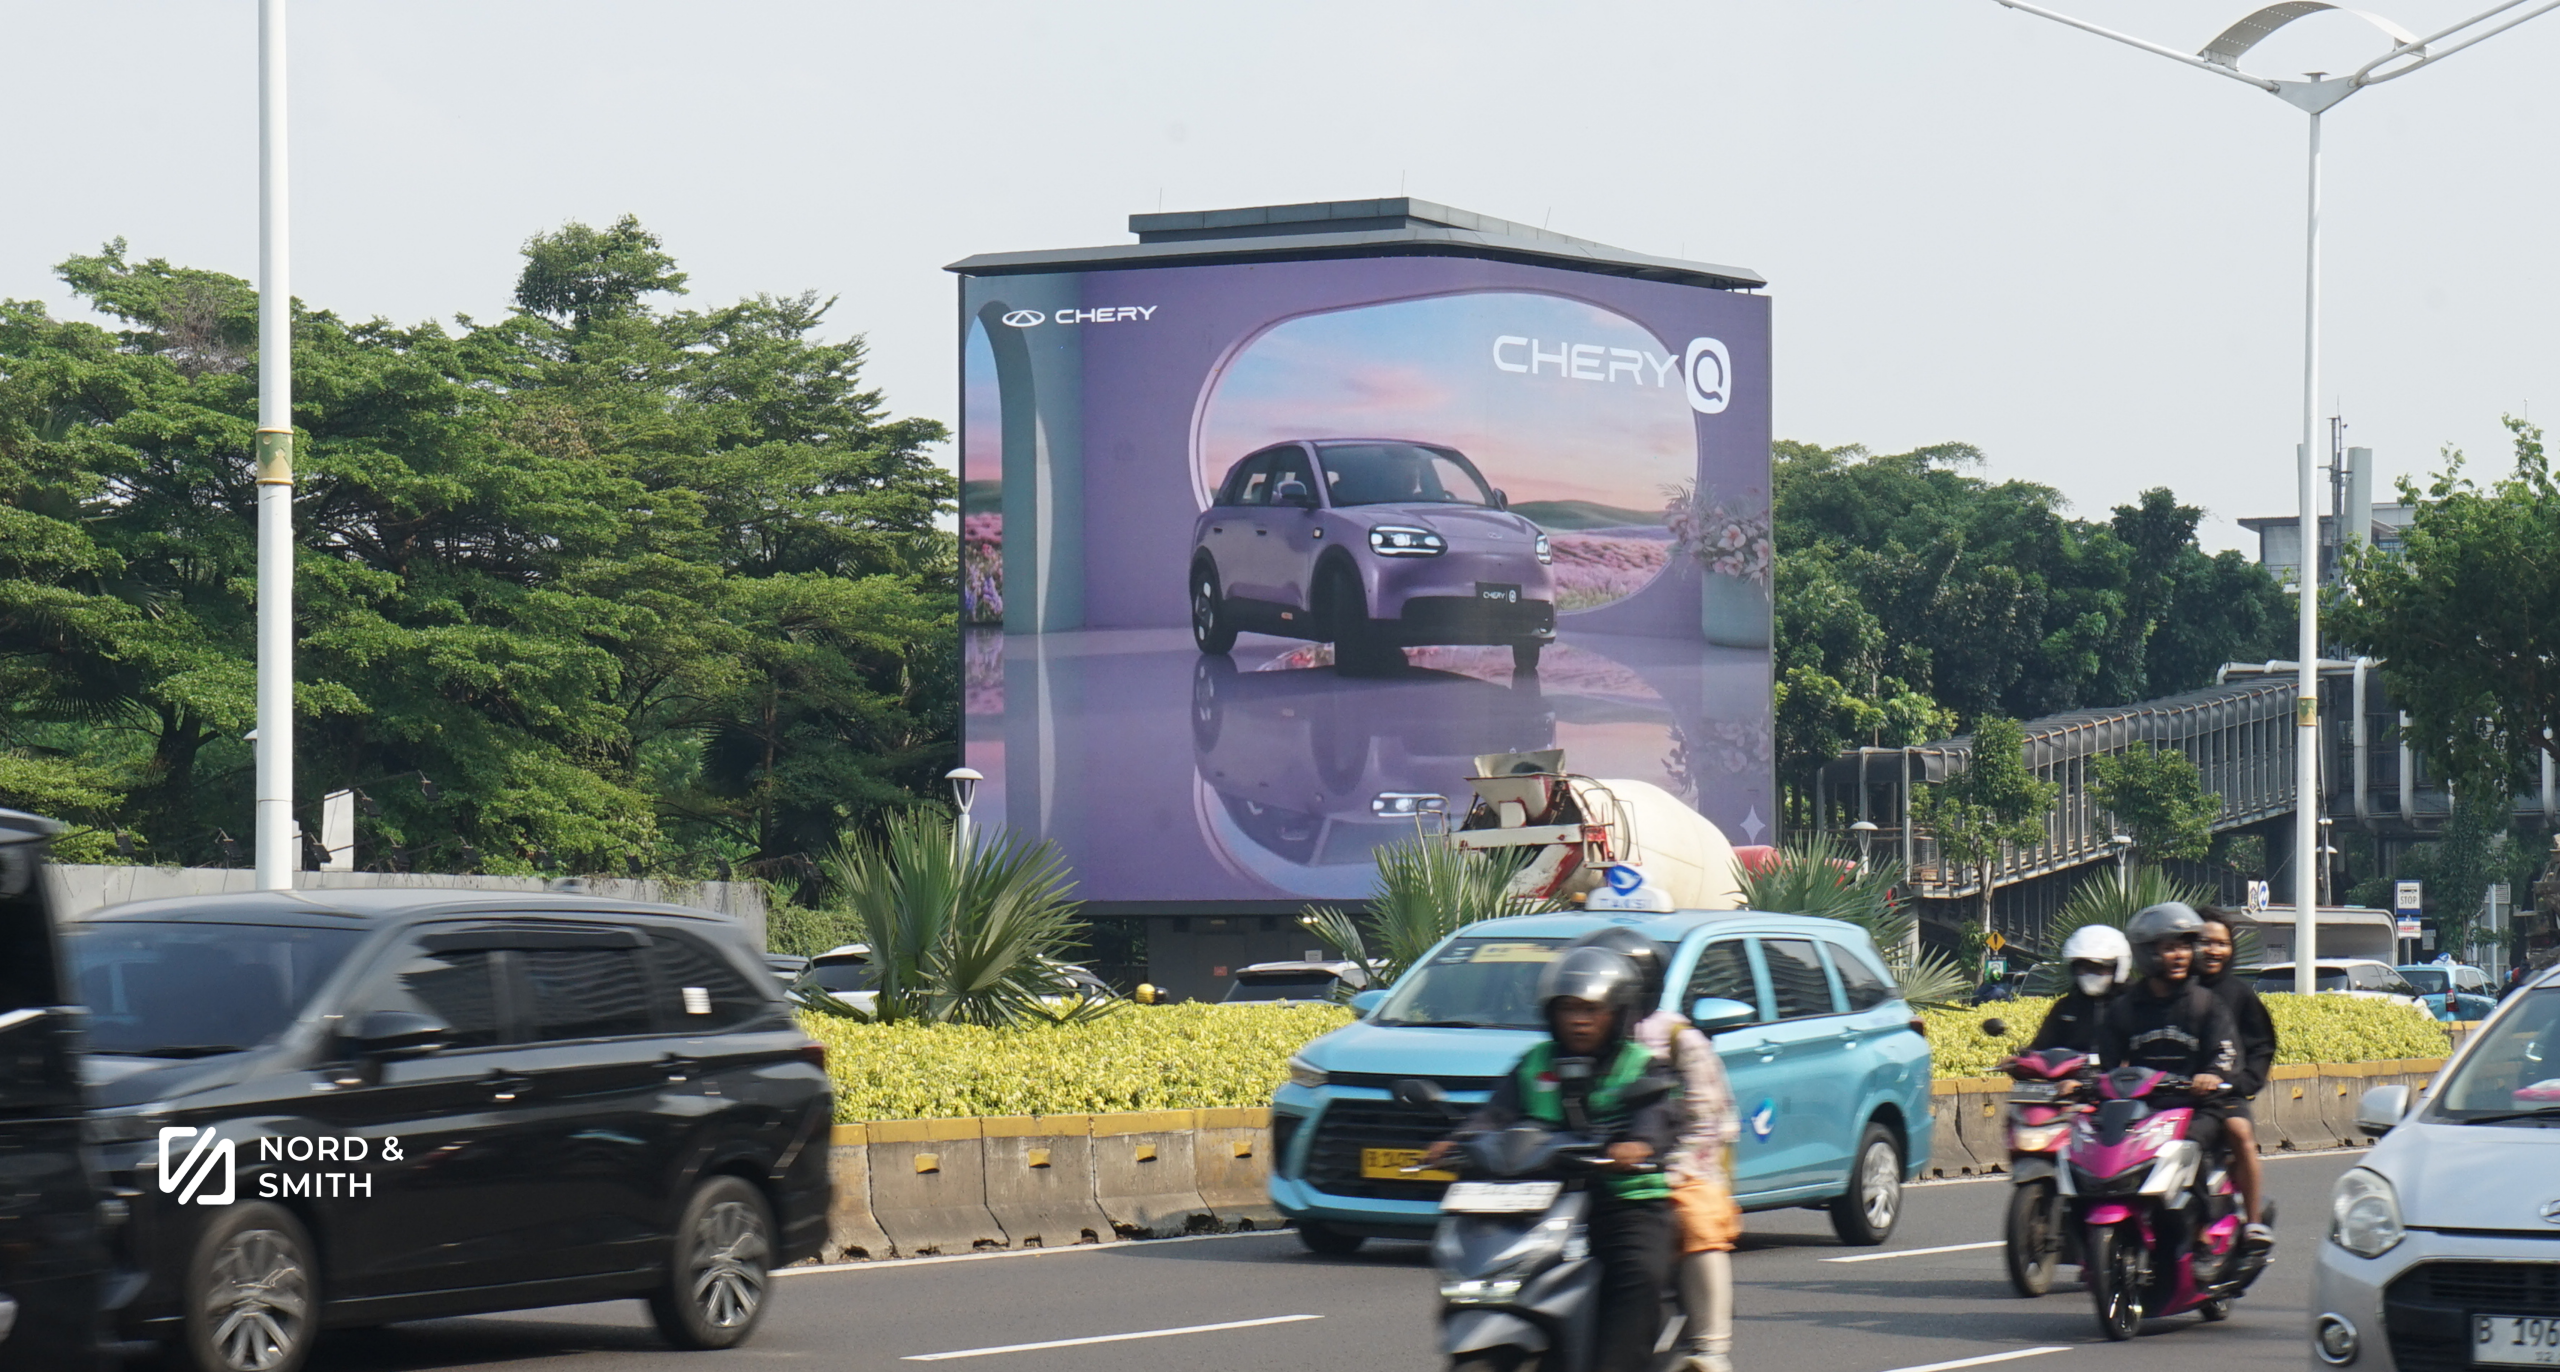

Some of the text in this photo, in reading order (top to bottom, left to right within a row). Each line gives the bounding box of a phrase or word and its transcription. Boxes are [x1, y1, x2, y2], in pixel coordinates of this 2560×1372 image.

[1055, 305, 1158, 325] CHERY
[1493, 335, 1729, 411] CHERY Q
[2400, 895, 2418, 905] STOP
[2474, 1317, 2494, 1344] B
